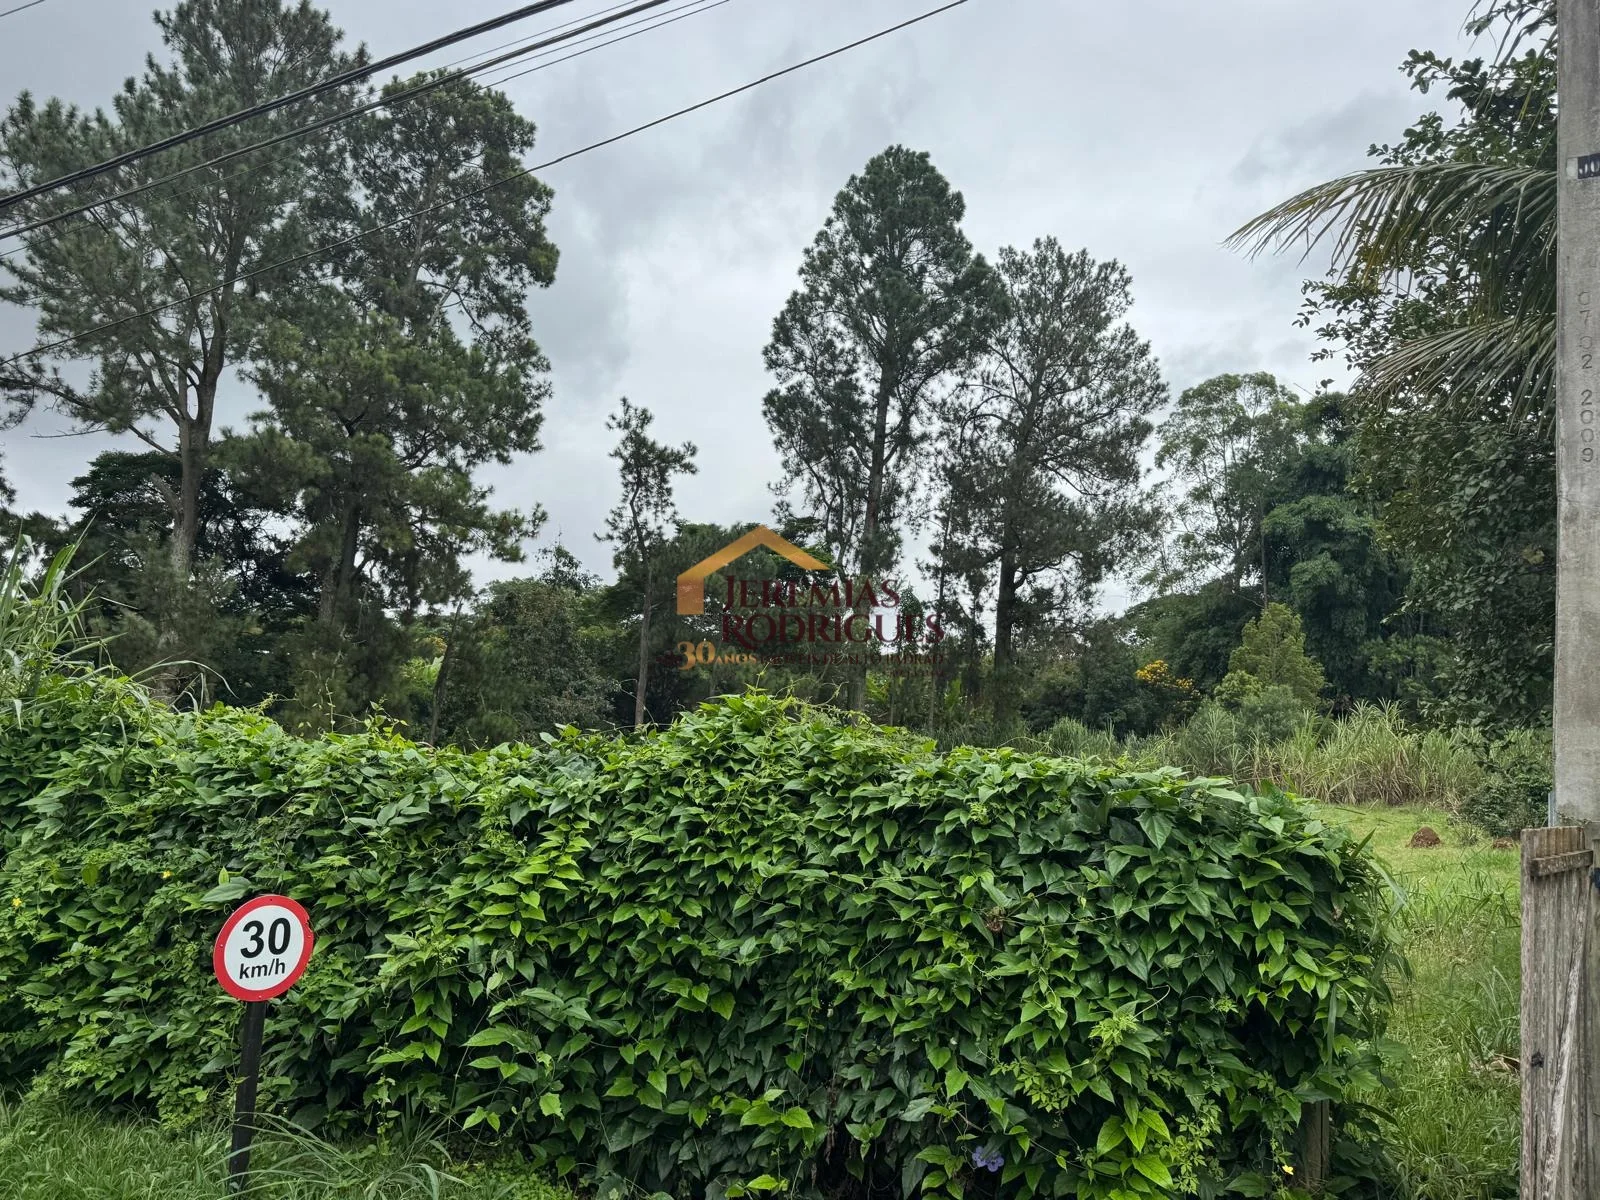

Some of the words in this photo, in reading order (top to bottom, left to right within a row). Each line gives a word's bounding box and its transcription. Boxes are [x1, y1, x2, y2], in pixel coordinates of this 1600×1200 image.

[1580, 389, 1594, 463] 2009
[240, 917, 291, 959] 30
[239, 958, 286, 980] km/h
